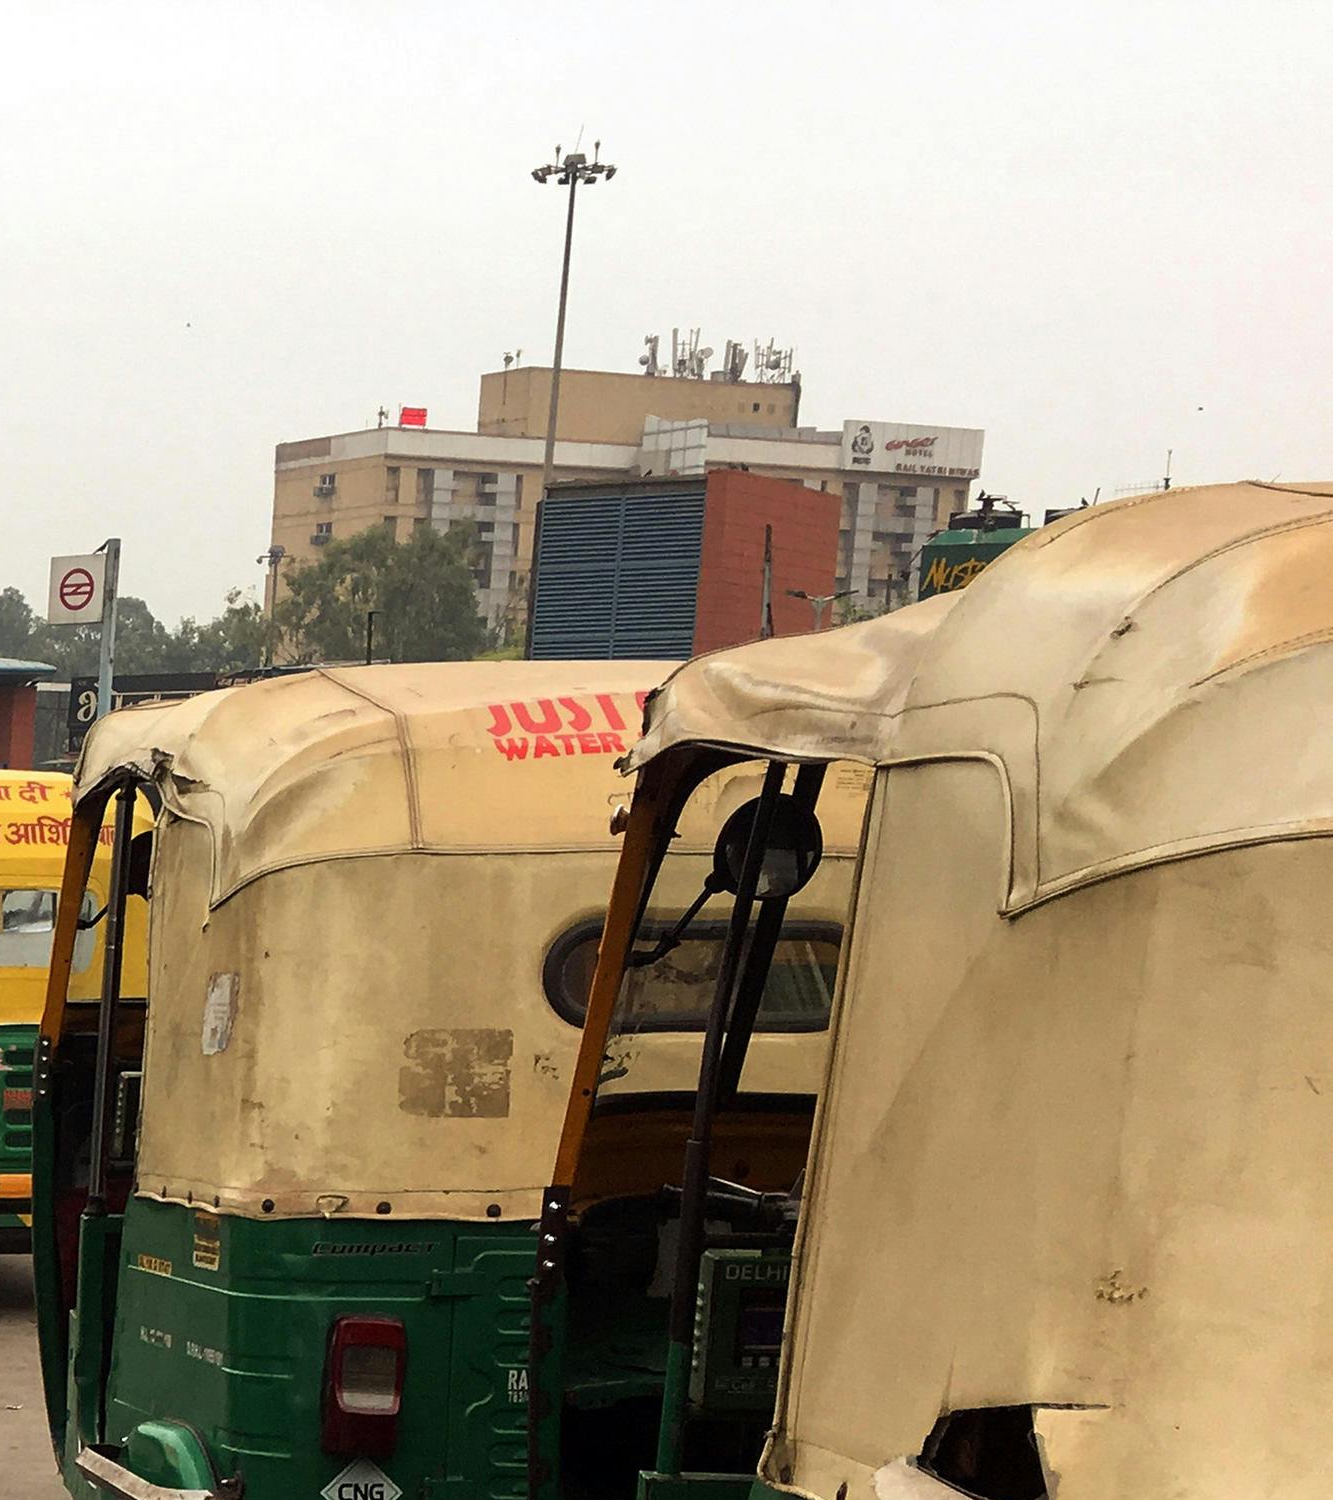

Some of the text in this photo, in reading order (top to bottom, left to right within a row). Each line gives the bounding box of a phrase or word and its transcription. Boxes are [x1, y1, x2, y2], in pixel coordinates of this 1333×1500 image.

[486, 695, 627, 737] JUST
[494, 732, 627, 761] WATER
[18, 781, 54, 804] दी
